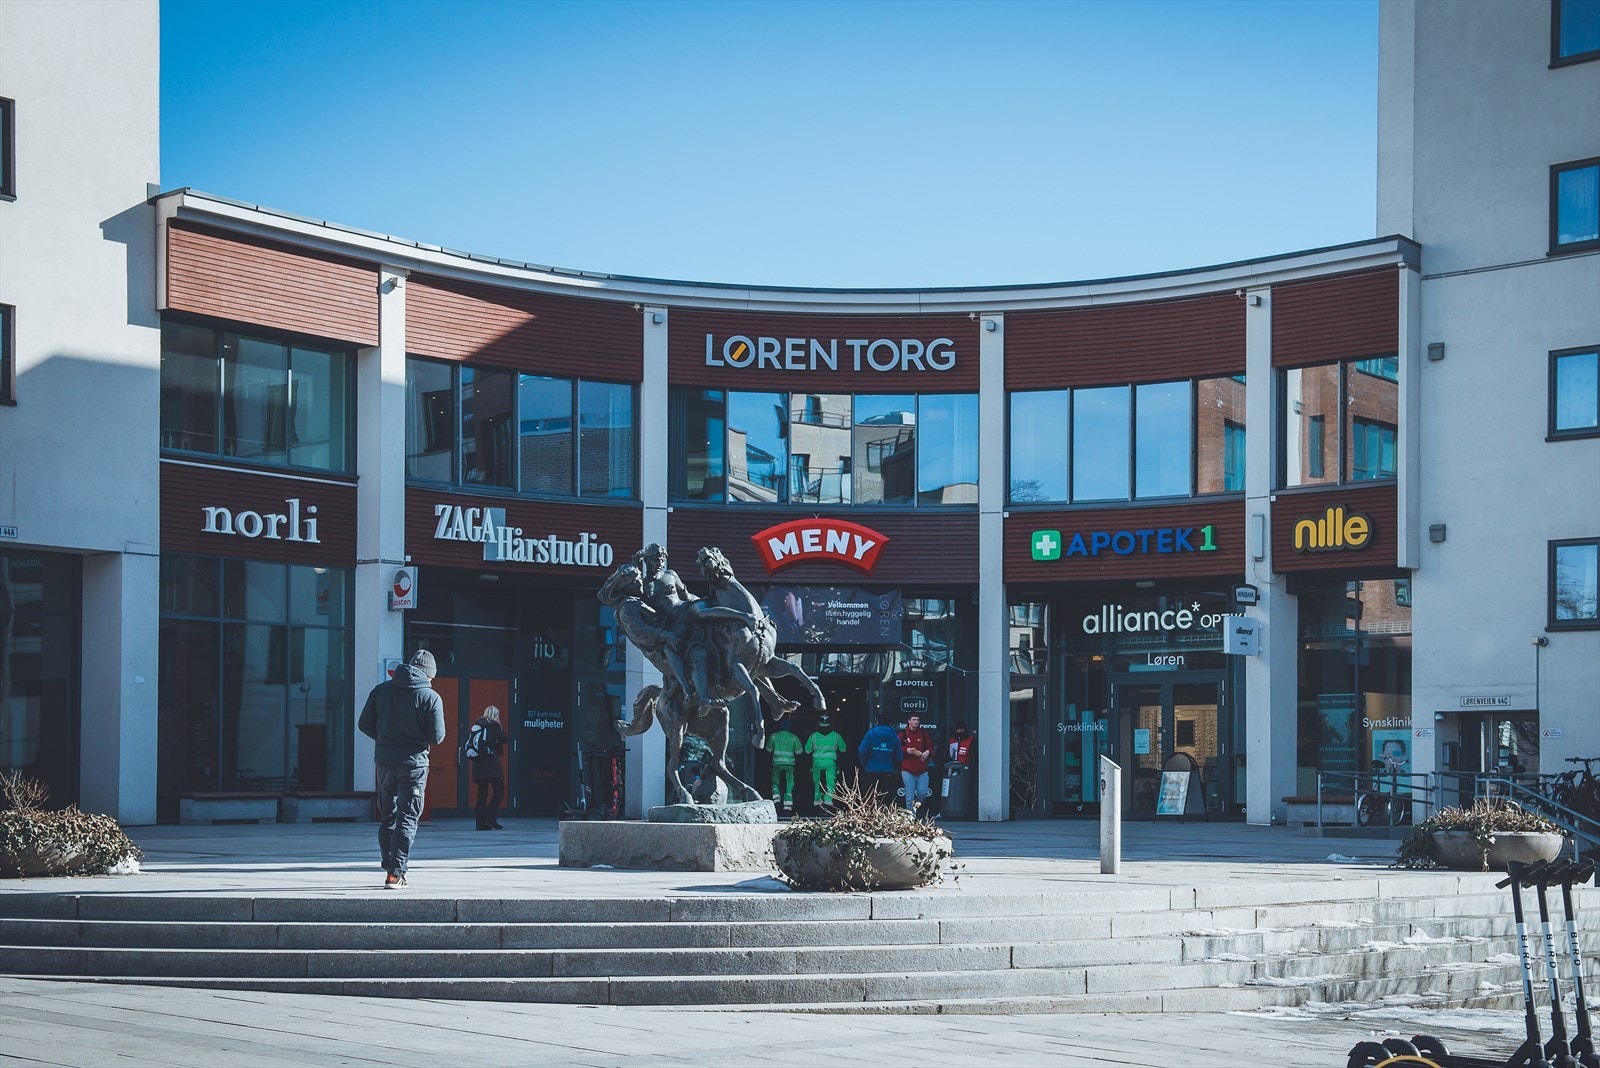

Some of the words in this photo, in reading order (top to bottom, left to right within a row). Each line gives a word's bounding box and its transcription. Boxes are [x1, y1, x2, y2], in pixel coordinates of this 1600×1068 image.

[705, 333, 838, 371] LØREN
[846, 337, 956, 372] TORG
[201, 498, 321, 544] norli
[434, 503, 497, 543] ZAGA
[496, 525, 614, 568] Hårstudio
[1294, 507, 1369, 549] nille
[768, 528, 876, 561] MENY
[1066, 527, 1194, 557] APOTEK
[1199, 524, 1217, 552] 1
[827, 601, 869, 609] Velkommen
[842, 610, 872, 619] hyggelig
[879, 594, 890, 636] LØREN
[836, 618, 860, 626] handel
[903, 660, 927, 669] MENY
[1147, 652, 1185, 667] Løren
[903, 700, 925, 708] norli
[524, 718, 565, 730] muligheter
[1057, 721, 1105, 733] Synsklinikk
[1520, 934, 1532, 970] BIRD
[1545, 933, 1557, 969] BIRD
[1570, 931, 1581, 967] BIRD
